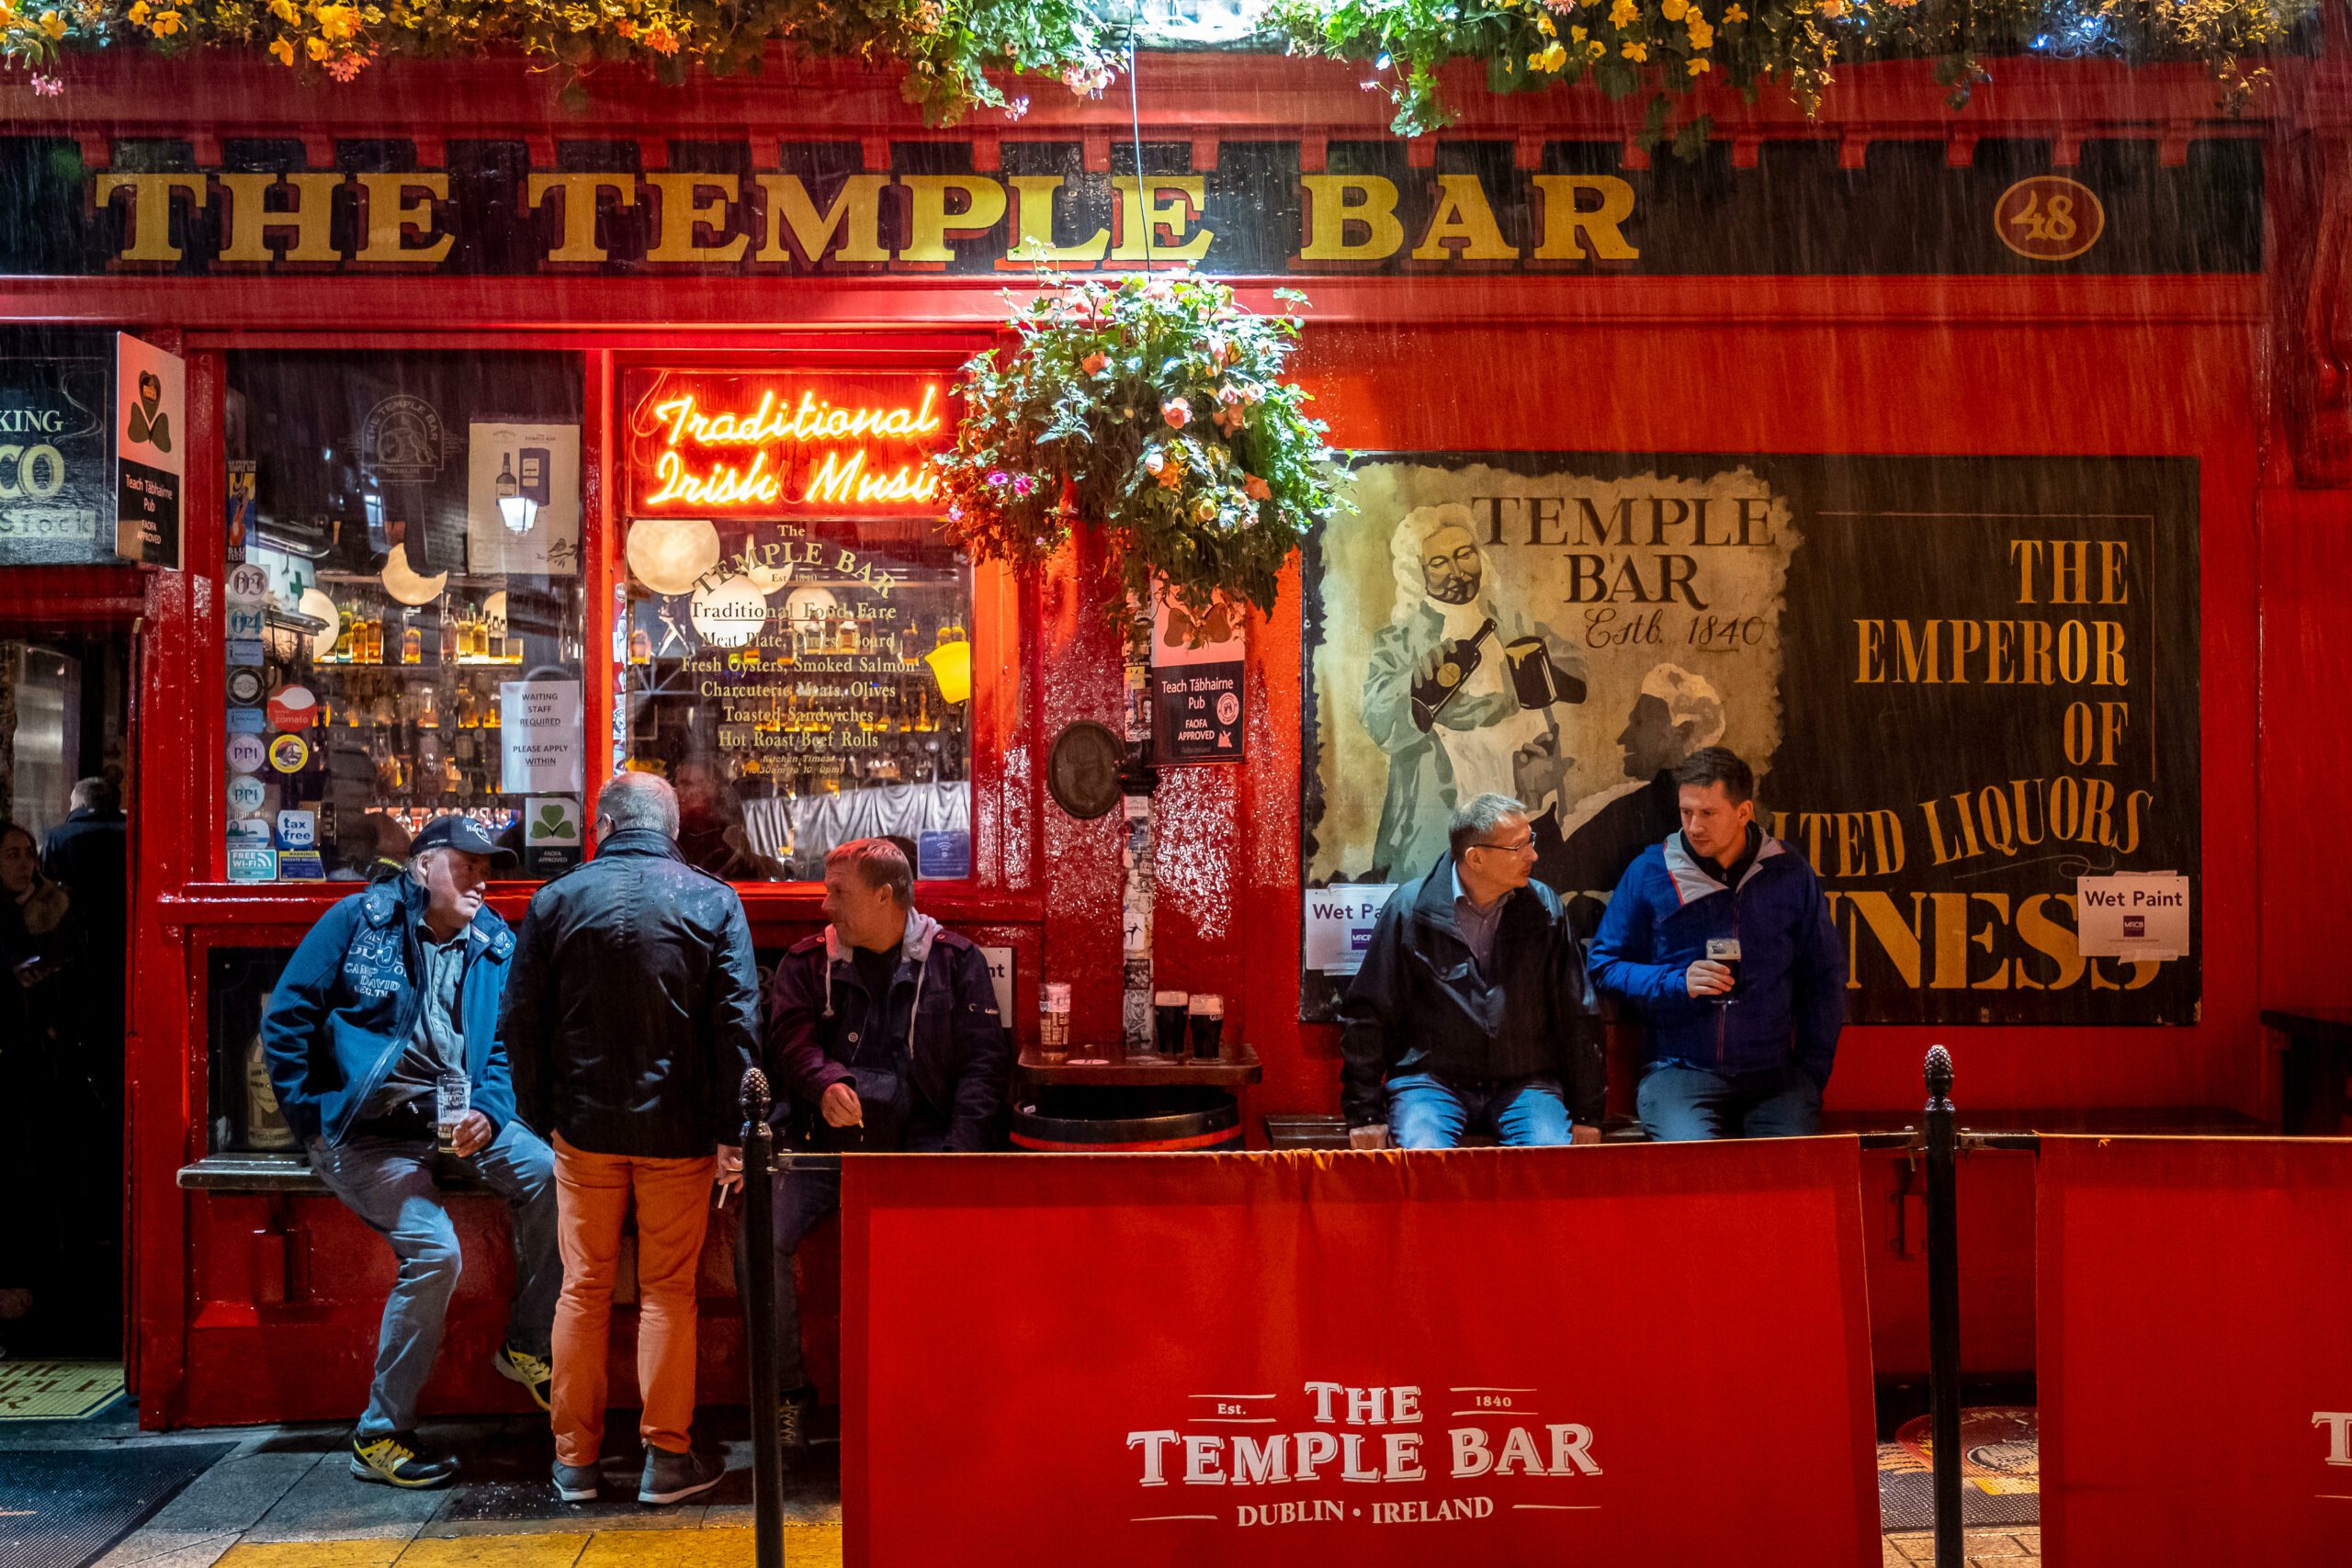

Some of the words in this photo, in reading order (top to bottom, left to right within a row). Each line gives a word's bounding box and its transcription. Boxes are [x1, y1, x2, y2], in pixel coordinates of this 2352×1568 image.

[96, 173, 456, 264] THE
[526, 173, 1213, 264] TEMPLE
[1301, 174, 1639, 263] BAR
[2009, 189, 2077, 241] 48
[380, 400, 427, 416] TEMPLE
[425, 414, 439, 442] BAR
[655, 385, 940, 446] Traditional
[125, 473, 143, 492] Teach
[647, 450, 779, 504] Irish
[807, 449, 939, 503] Musi
[143, 497, 155, 513] Pub
[1472, 496, 1777, 547] TEMPLE
[137, 529, 162, 545] APPROVED
[777, 525, 806, 537] The
[692, 541, 823, 596] TEMPLE
[834, 549, 896, 599] BAR
[2010, 539, 2128, 604] THE
[1563, 553, 1709, 612] BAR
[691, 602, 794, 619] Traditional
[804, 602, 846, 619] Food
[856, 602, 897, 619] Fare
[1687, 615, 1767, 645] 1840
[701, 631, 741, 648] Meat
[746, 631, 787, 649] Plate,
[1852, 618, 2129, 686] EMPEROR
[682, 657, 722, 672] Fresh
[729, 657, 787, 678] Oysters,
[794, 657, 853, 673] Smoked
[859, 657, 915, 673] Salmon
[700, 681, 791, 698] Charcuterie
[851, 681, 897, 698] Olives
[1161, 679, 1187, 694] Teach
[1189, 677, 1234, 692] Tábhairne
[1188, 696, 1205, 710] Pub
[723, 705, 781, 722] Toasted
[787, 705, 874, 722] Sandwiches
[520, 718, 560, 727] REQUIRED
[1185, 718, 1208, 728] FAOFA
[718, 730, 747, 747] Hot
[754, 730, 795, 747] Roast
[801, 730, 836, 747] Beef
[842, 730, 879, 747] Rolls
[1178, 730, 1216, 741] APPROVED
[2064, 701, 2129, 765] OF
[234, 747, 257, 760] PPI
[543, 745, 569, 753] APPLY
[234, 789, 258, 801] PPI
[283, 817, 306, 829] tax
[1918, 775, 2154, 866] LIQUORS
[283, 829, 311, 841] free
[232, 852, 255, 860] FREE
[2085, 891, 2125, 907] Wet
[2133, 890, 2183, 907] Paint
[1312, 903, 1353, 919] Wet
[344, 962, 379, 977] CAMP
[359, 975, 401, 992] DAVID
[1217, 1403, 1247, 1416] Est.
[1304, 1381, 1424, 1426] THE
[1475, 1395, 1512, 1408] 1840
[1126, 1429, 1427, 1487] TEMPLE
[1448, 1423, 1604, 1479] BAR
[1238, 1500, 1345, 1528] DUBLIN
[1372, 1496, 1494, 1525] IRELAND
